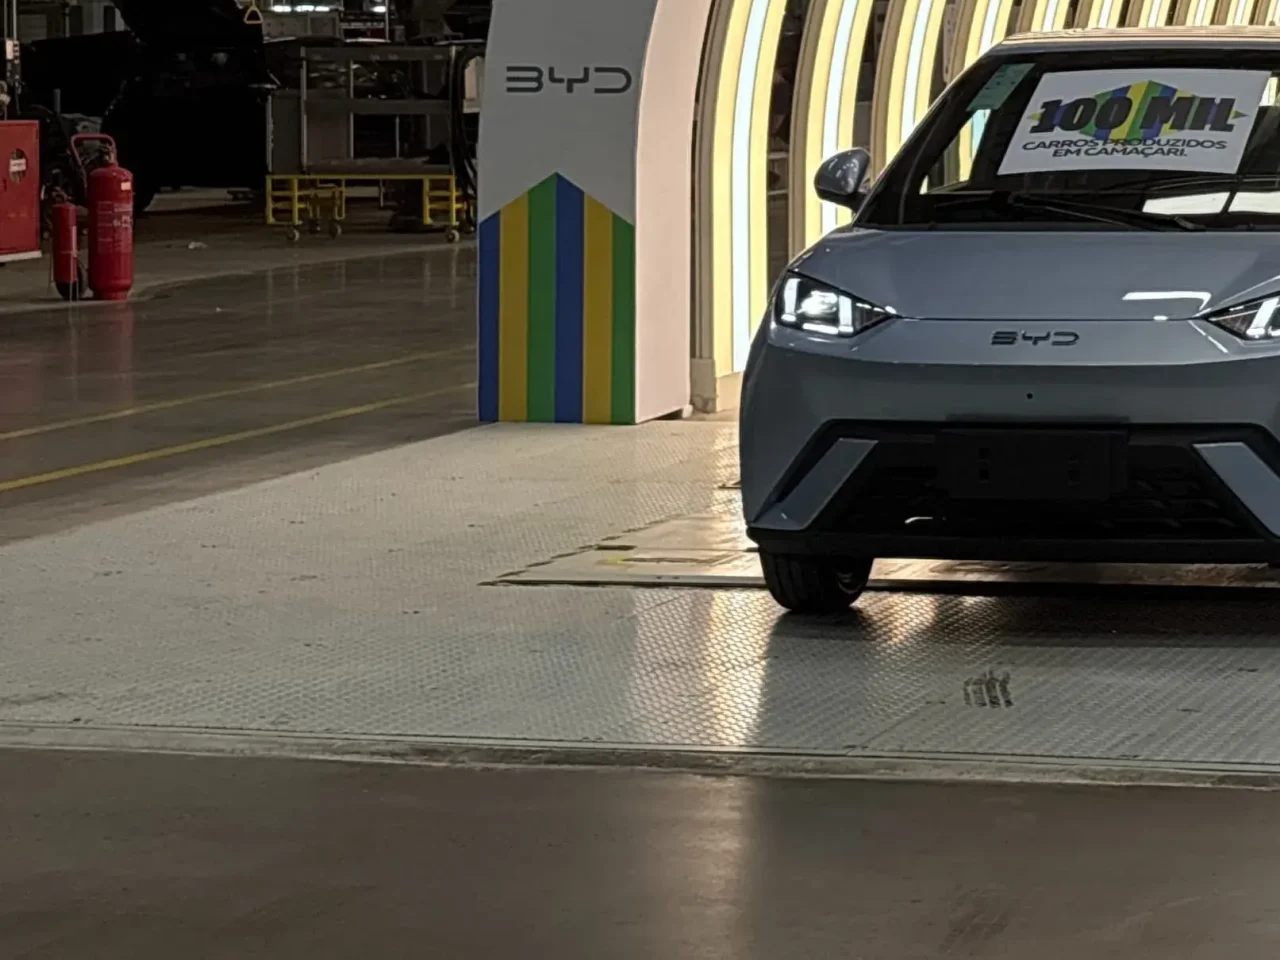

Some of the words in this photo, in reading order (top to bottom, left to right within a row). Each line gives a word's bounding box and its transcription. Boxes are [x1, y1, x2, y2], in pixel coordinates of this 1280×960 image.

[506, 66, 632, 93] BYD
[1029, 97, 1132, 133] 100
[1138, 95, 1236, 132] MIL
[1022, 139, 1099, 151] CARROS
[1102, 138, 1228, 150] PRODUZIDOS
[1052, 148, 1081, 157] EM
[1084, 146, 1188, 158] CAMAÇARI.
[991, 331, 1079, 346] BYD
